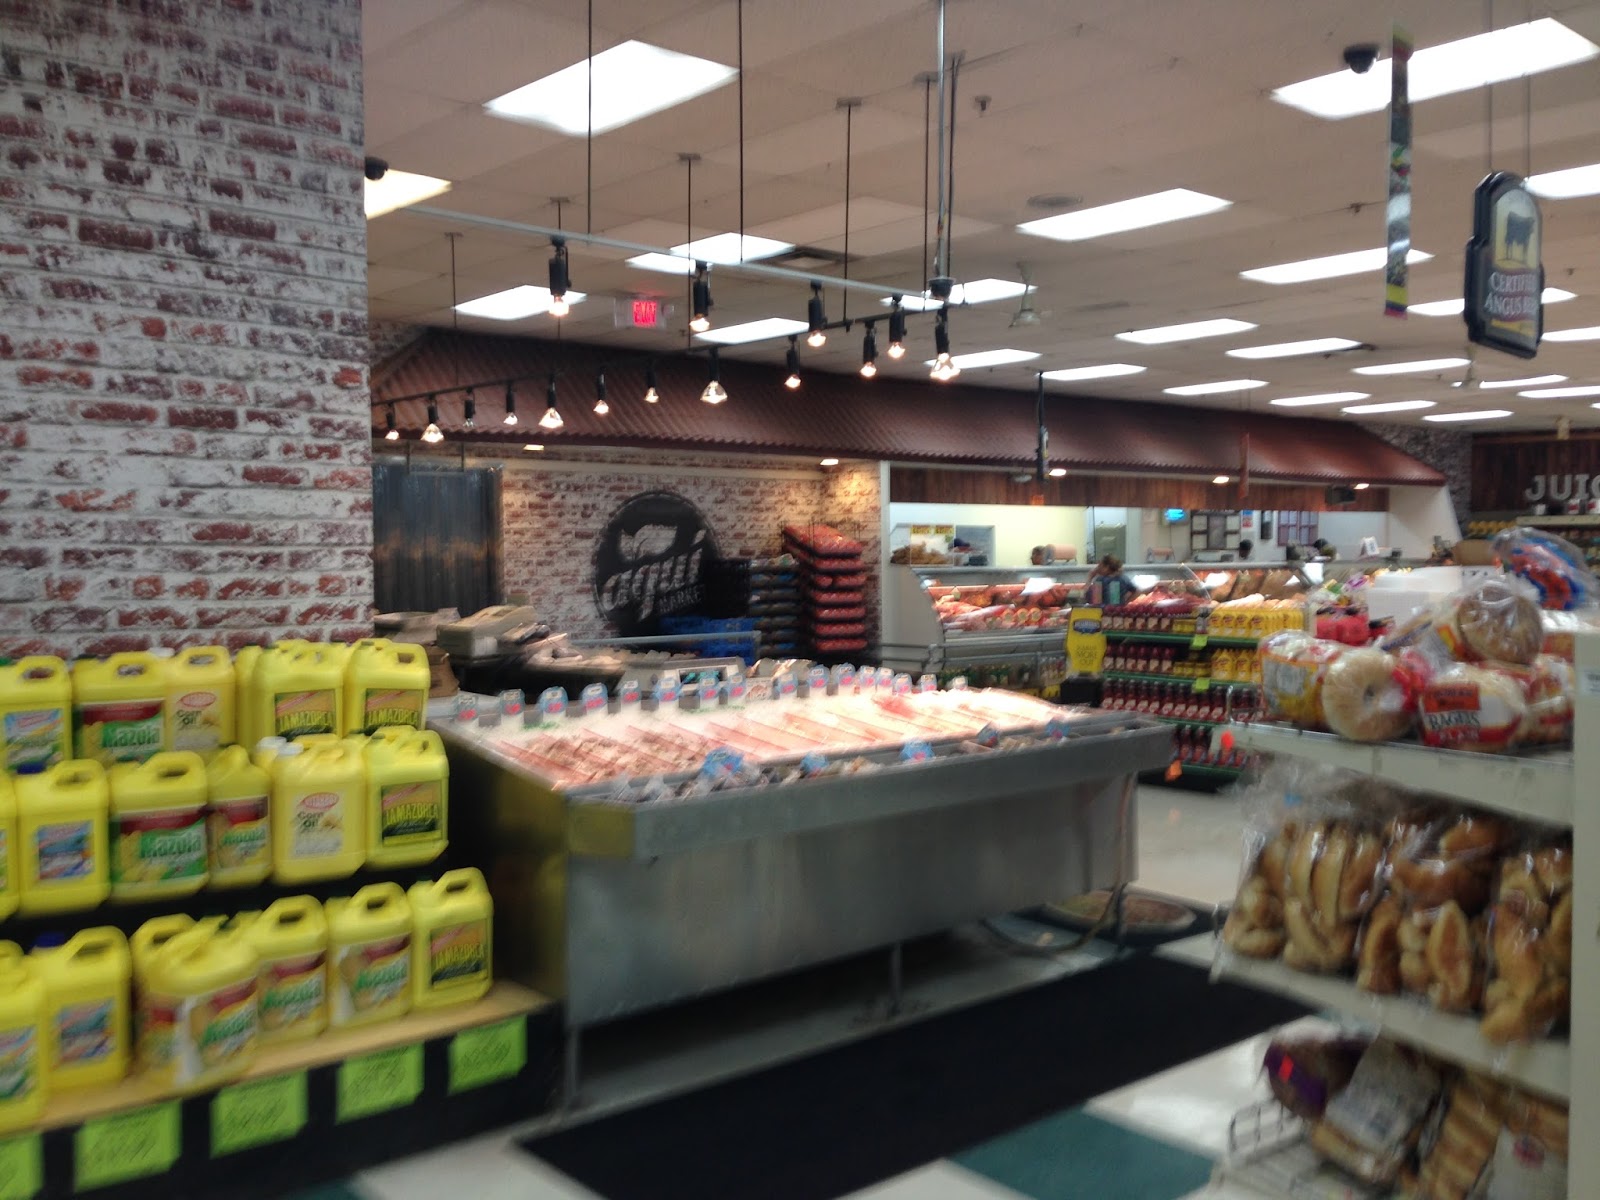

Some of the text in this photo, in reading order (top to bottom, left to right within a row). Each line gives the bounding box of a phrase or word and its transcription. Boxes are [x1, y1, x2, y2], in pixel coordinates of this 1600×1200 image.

[632, 301, 657, 326] EXIT
[1484, 293, 1521, 316] ANGUS
[658, 584, 703, 613] MARKE
[103, 726, 160, 748] Mazola
[141, 832, 202, 859] Mazola
